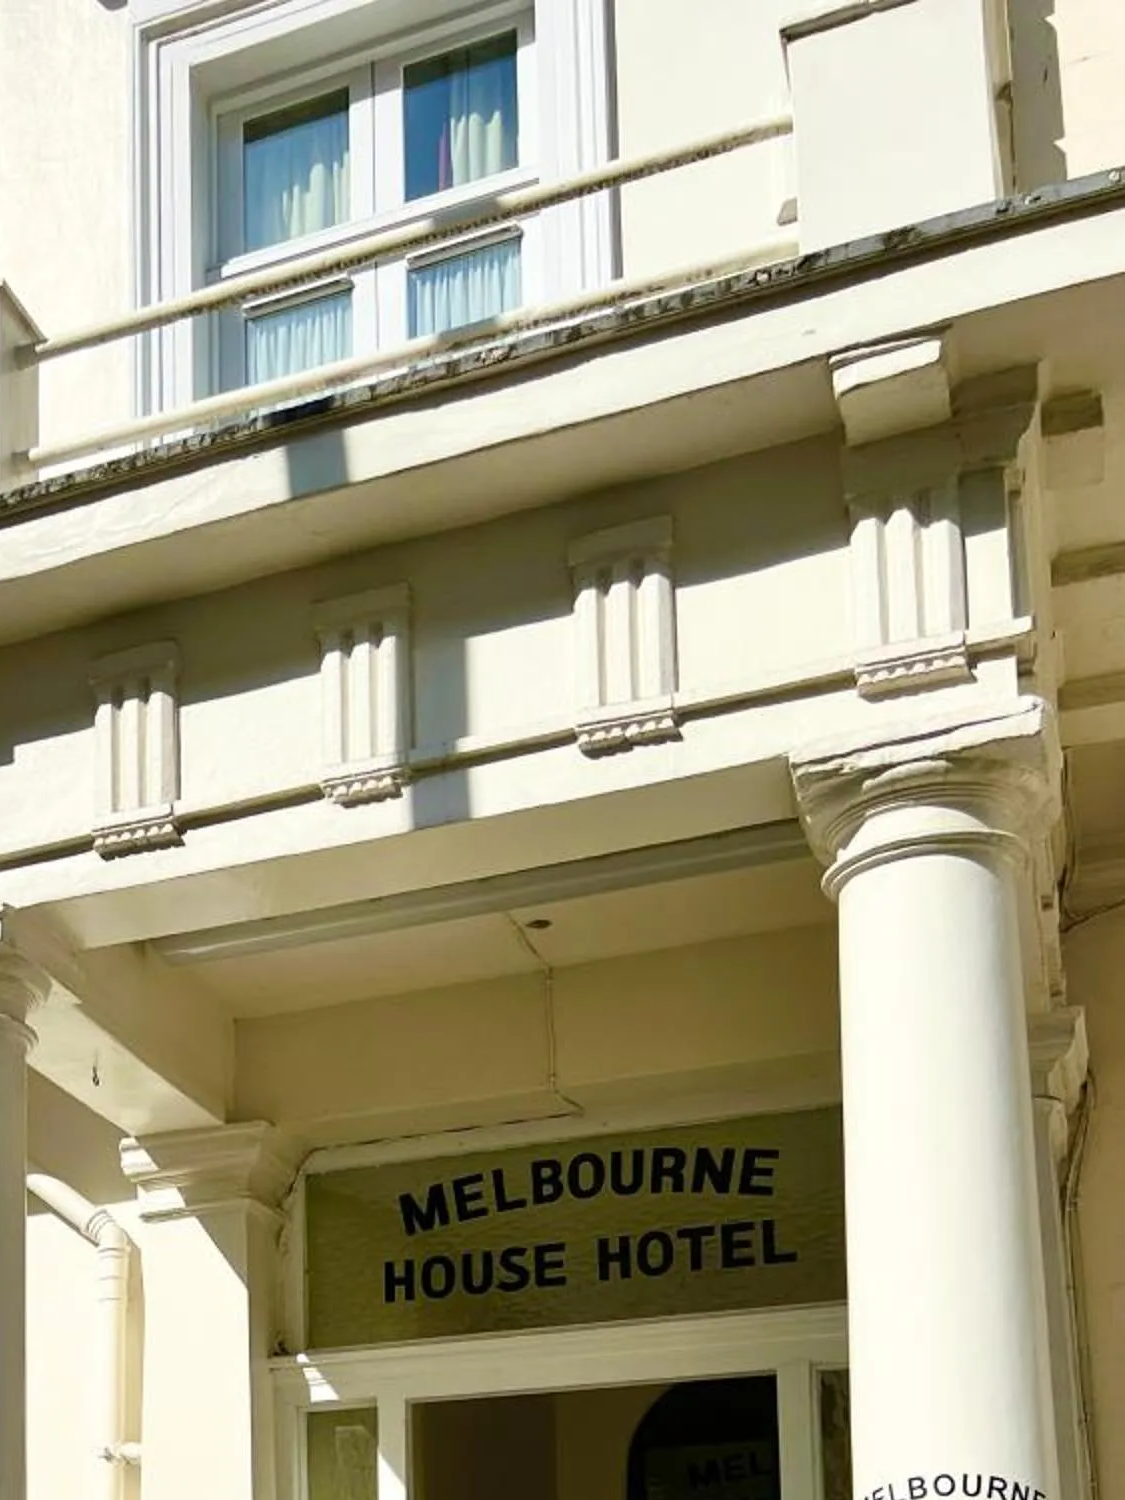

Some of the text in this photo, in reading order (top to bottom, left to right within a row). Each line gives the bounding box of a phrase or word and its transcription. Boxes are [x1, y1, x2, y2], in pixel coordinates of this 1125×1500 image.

[399, 1147, 779, 1235] MELBOURNE
[383, 1218, 796, 1302] HOUSE HOTEL
